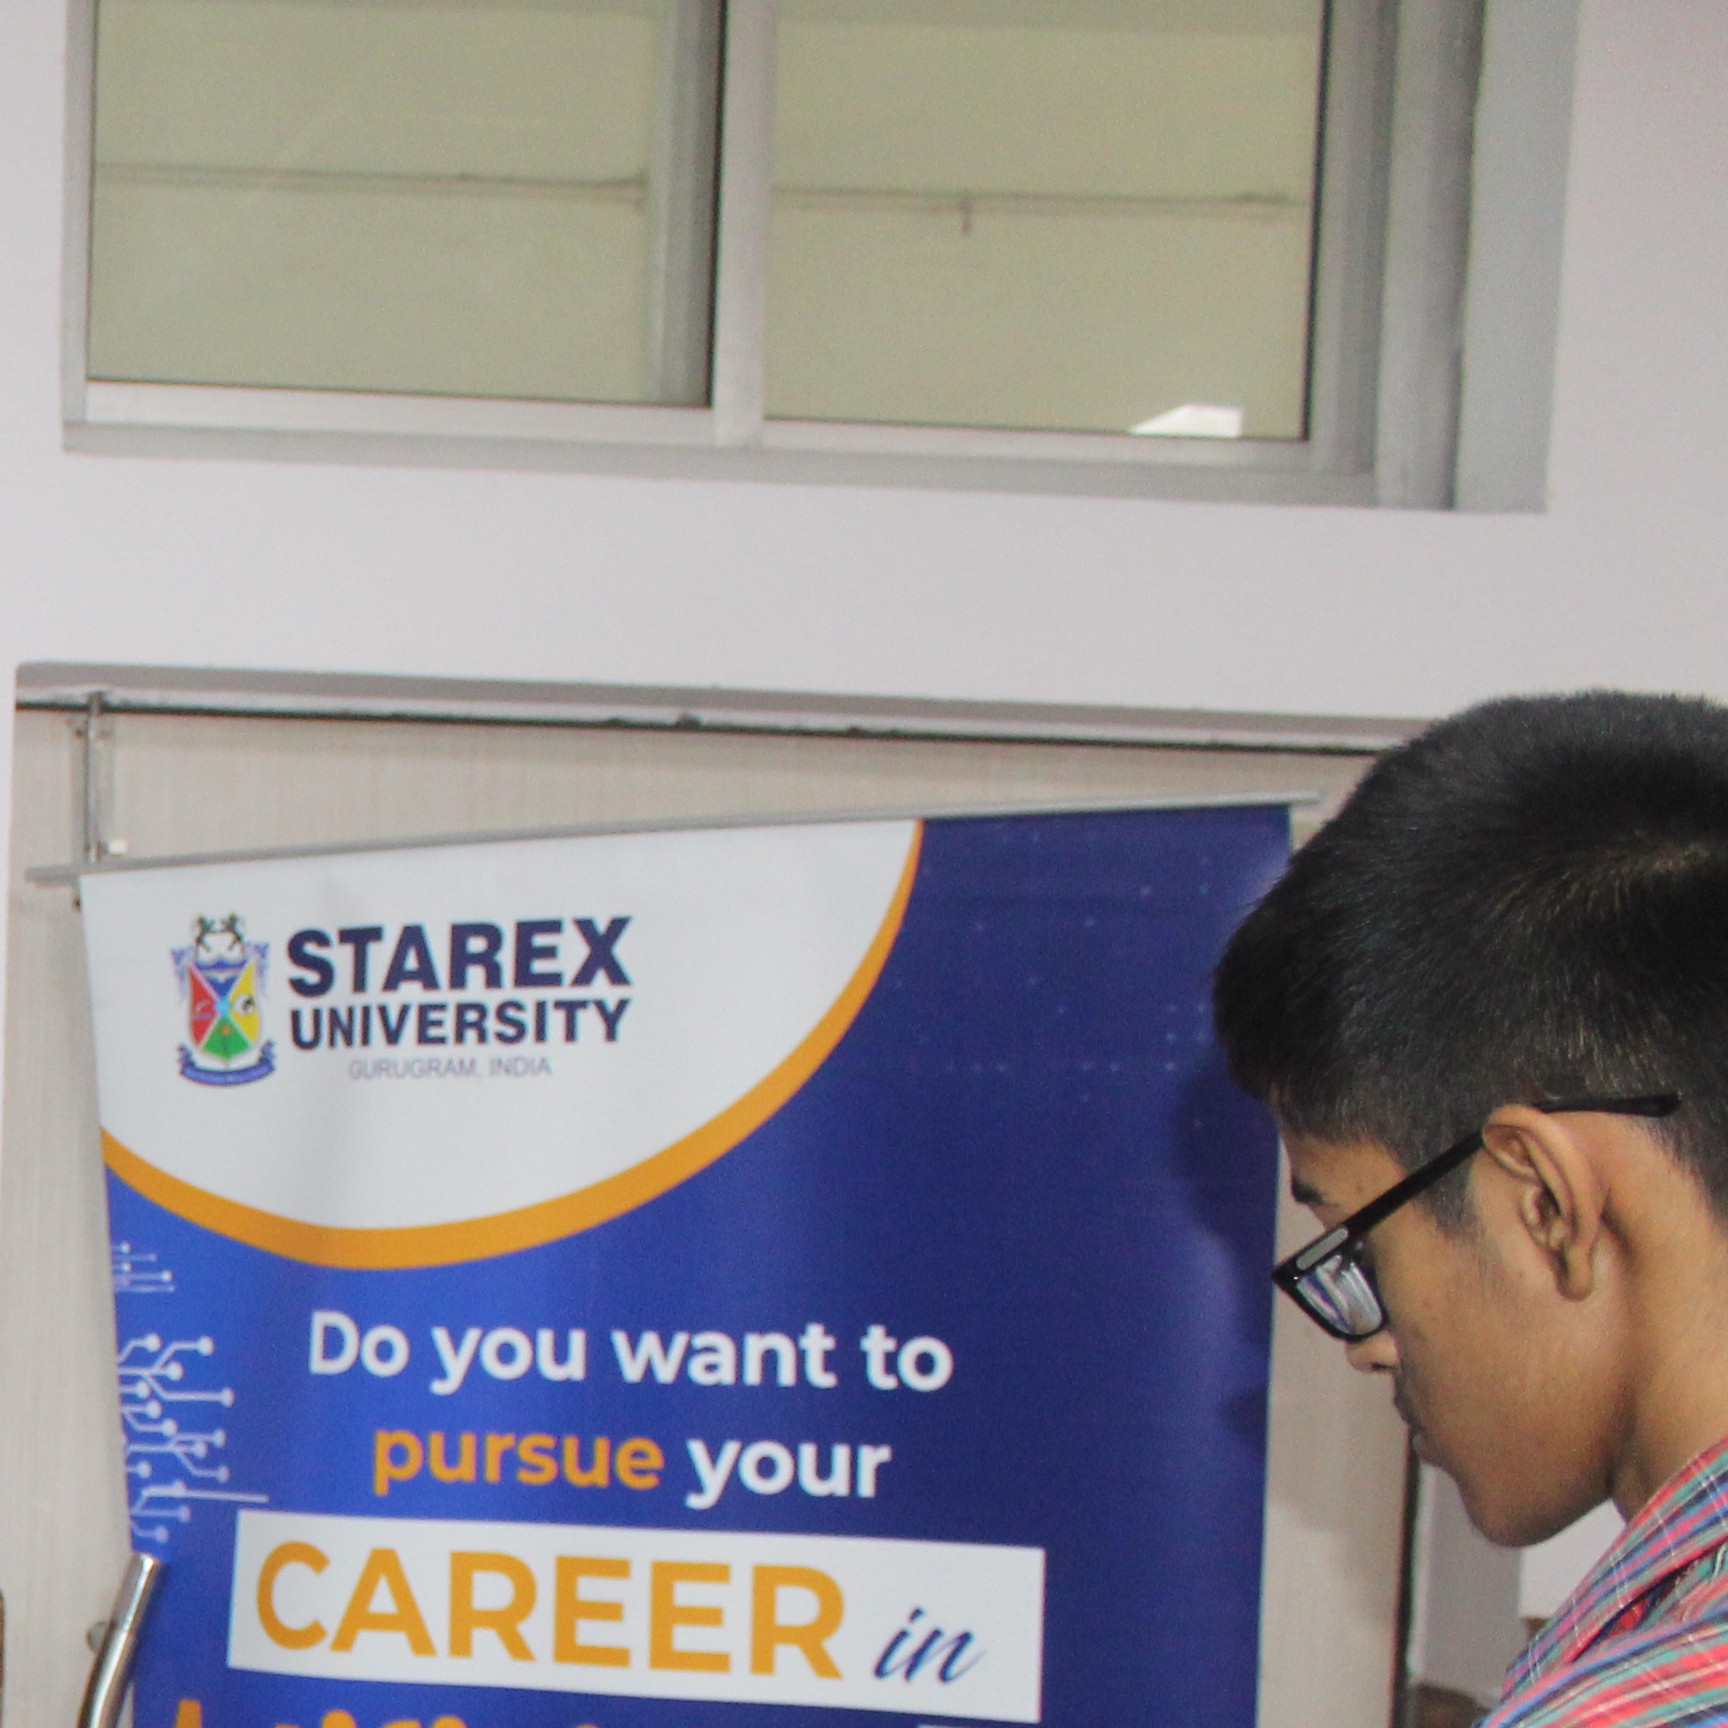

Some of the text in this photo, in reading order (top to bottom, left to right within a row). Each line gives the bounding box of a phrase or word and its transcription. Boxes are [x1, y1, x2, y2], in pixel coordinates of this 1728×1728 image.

[286, 915, 632, 997] STAREX
[290, 997, 631, 1050] UNIVERSITY
[488, 1054, 552, 1078] INDIA
[308, 1309, 955, 1396] Do you want to
[372, 1427, 892, 1508] pursue your
[255, 1540, 984, 1687] CAREER in
